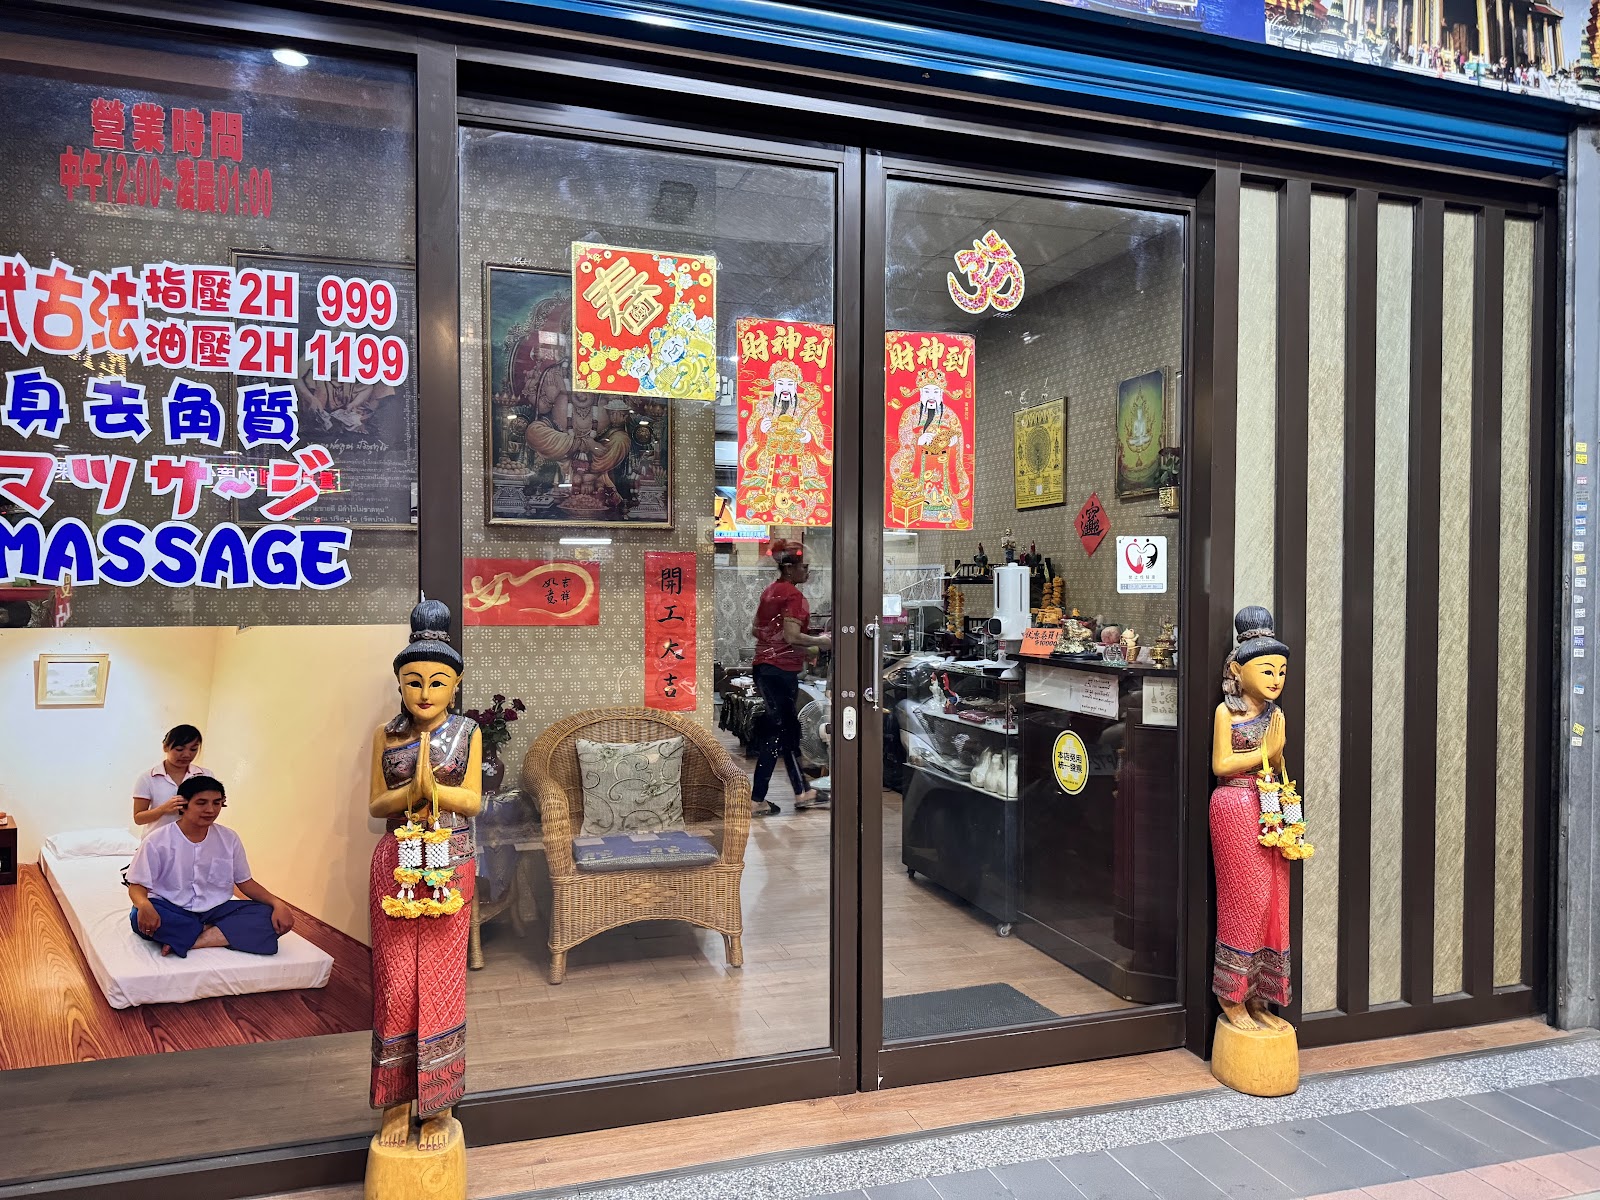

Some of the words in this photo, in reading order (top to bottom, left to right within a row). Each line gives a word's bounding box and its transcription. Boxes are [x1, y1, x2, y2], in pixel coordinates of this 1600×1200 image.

[91, 97, 243, 162] 營業時間
[320, 279, 392, 326] 999
[309, 333, 404, 382] 1199
[740, 325, 831, 369] 財神到
[888, 336, 971, 378] 財神到
[6, 371, 300, 446] 身去角質
[0, 522, 347, 585] MASSAGE
[657, 566, 685, 698] 開工大吉
[1057, 751, 1082, 764] 本店免用
